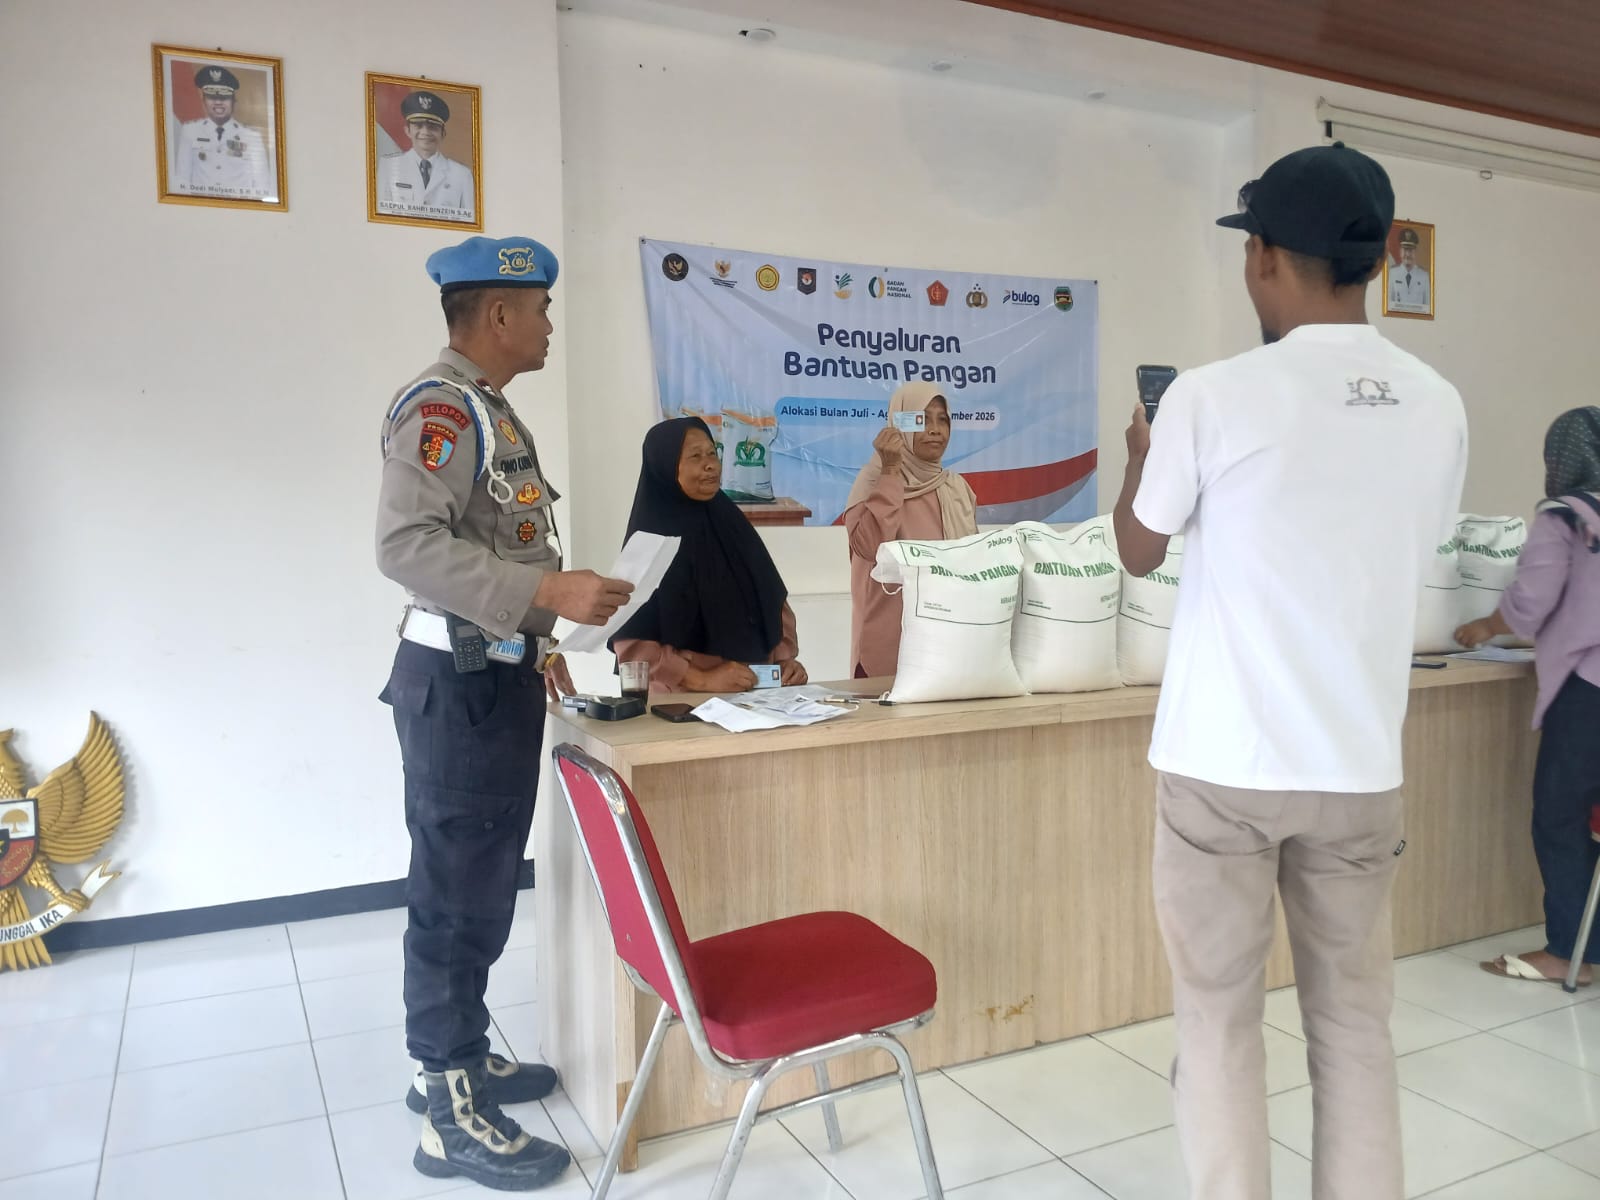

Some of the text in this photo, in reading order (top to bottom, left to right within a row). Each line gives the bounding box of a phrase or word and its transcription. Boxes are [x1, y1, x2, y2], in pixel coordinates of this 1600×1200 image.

[1011, 290, 1040, 306] bulog
[817, 323, 961, 356] Penyaluran
[783, 351, 996, 389] Bantuan Pangan
[422, 405, 466, 425] PELOPOR
[780, 405, 818, 417] Alokasi
[820, 407, 849, 418] Bulan
[850, 407, 869, 418] Juli
[975, 412, 995, 421] 2026
[980, 564, 1019, 581] PANGAN
[1033, 562, 1084, 577] BANTUAN
[39, 910, 63, 929] IKA
